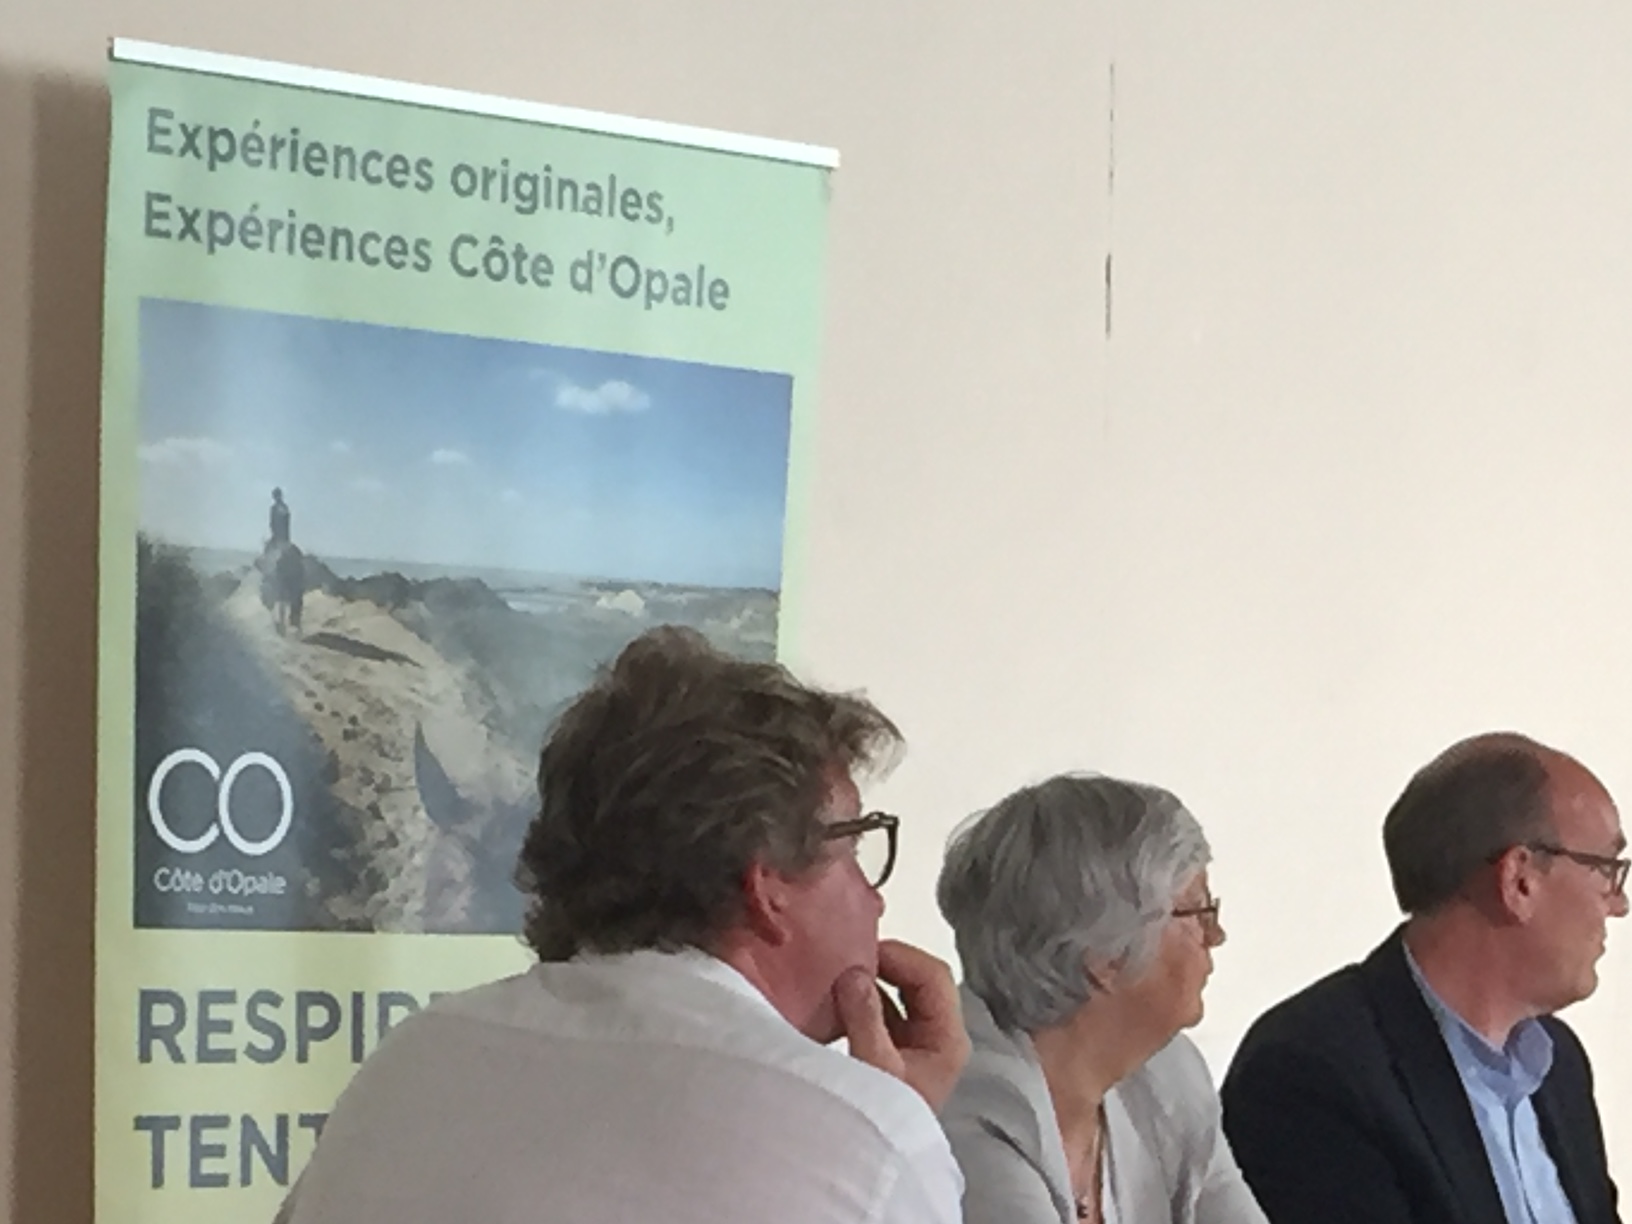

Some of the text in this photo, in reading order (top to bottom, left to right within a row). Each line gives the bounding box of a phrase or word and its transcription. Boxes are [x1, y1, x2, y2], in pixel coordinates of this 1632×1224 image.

[146, 107, 675, 236] Expériences originales,
[143, 191, 731, 312] Expériences Côte d'Opale
[153, 867, 204, 893] Côte
[137, 988, 455, 1064] RESPI
